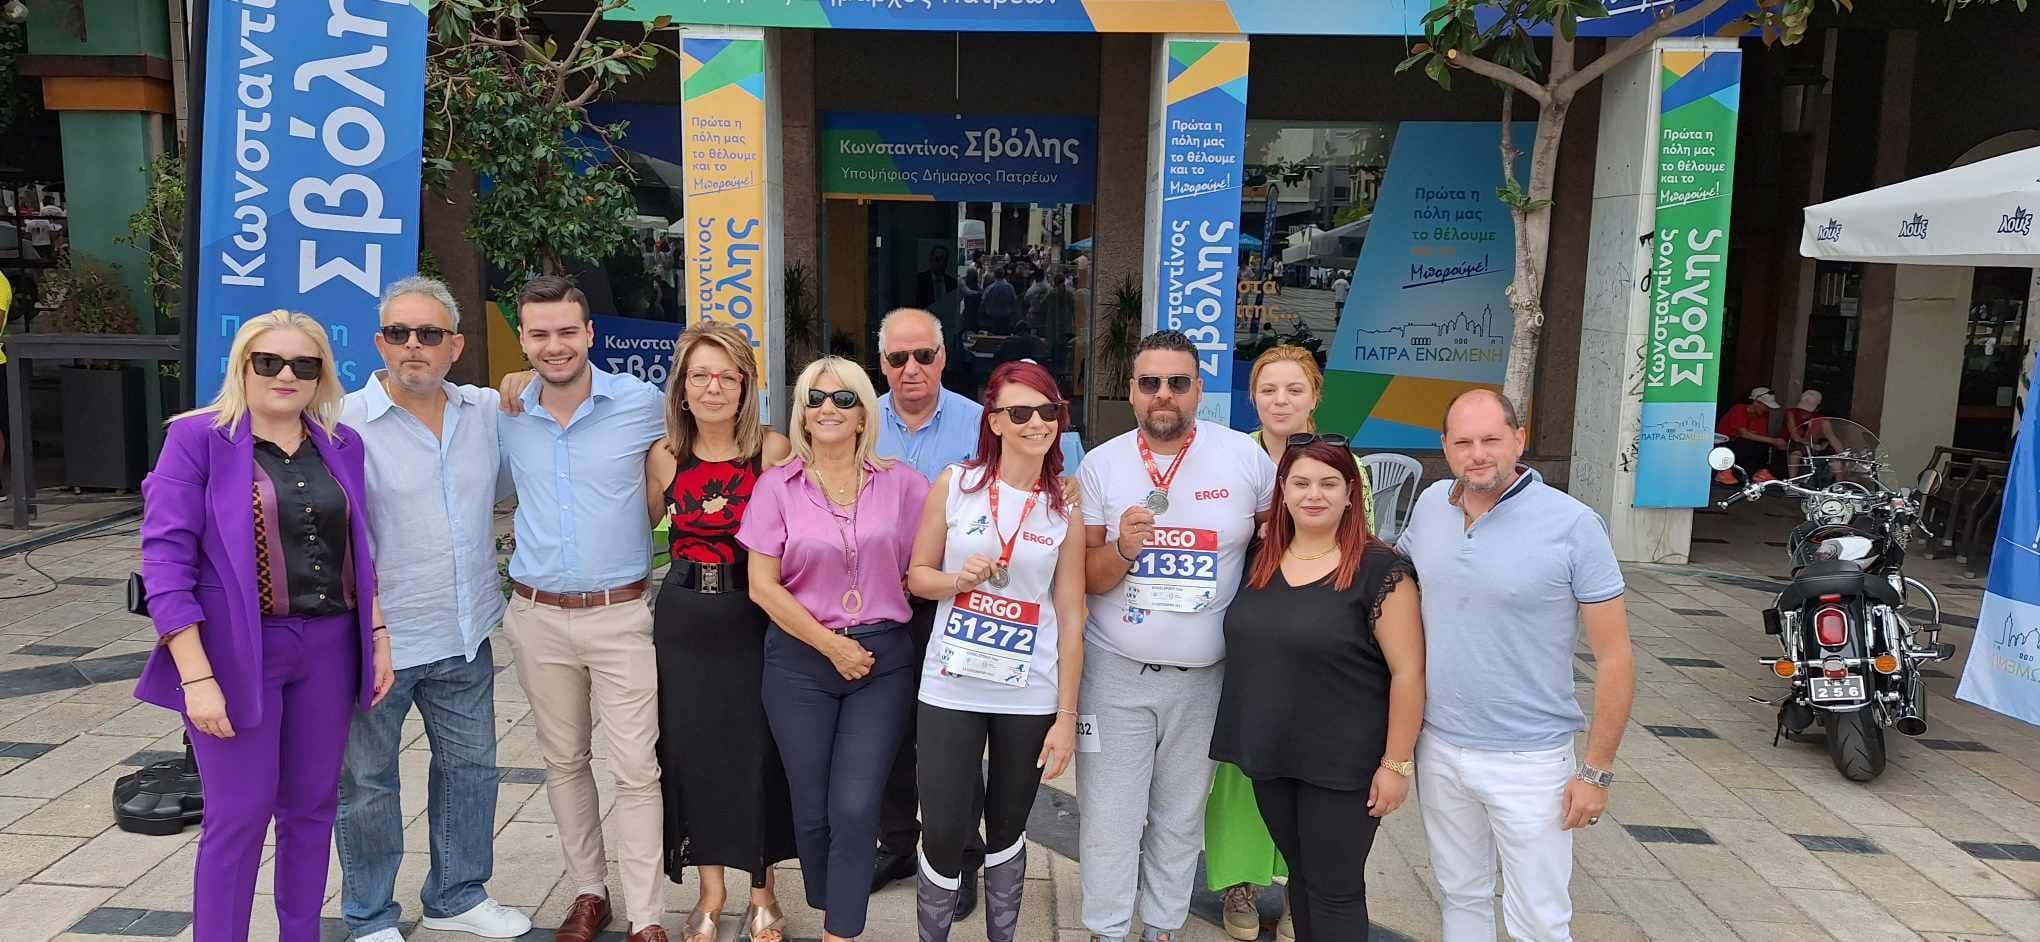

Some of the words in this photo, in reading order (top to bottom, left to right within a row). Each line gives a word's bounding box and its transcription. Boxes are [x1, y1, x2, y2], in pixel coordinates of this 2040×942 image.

[691, 116, 731, 128] Πρώτα
[735, 119, 742, 130] η
[1171, 119, 1212, 132] Πρώτα
[1215, 123, 1222, 133] η
[692, 131, 720, 144] πόλη
[724, 135, 746, 144] μας
[1171, 134, 1200, 148] πόλη
[1203, 137, 1225, 148] μας
[1663, 128, 1703, 141] Πρώτα
[1706, 131, 1713, 141] η
[221, 0, 277, 287] Κωνσταντί
[289, 0, 409, 297] Σβόλη
[839, 138, 960, 159] Κωνσταντίνος
[964, 127, 1080, 165] Σβόλης
[1663, 143, 1691, 156] πόλη
[1694, 147, 1716, 156] μας
[693, 151, 705, 159] το
[709, 148, 757, 161] θέλουμε
[1171, 155, 1184, 163] το
[1187, 152, 1236, 165] θέλουμε
[692, 162, 711, 171] και
[714, 163, 727, 171] το
[1170, 167, 1188, 175] και
[1191, 167, 1205, 175] το
[1662, 163, 1674, 171] το
[1678, 160, 1726, 173] θέλουμε
[841, 166, 918, 185] Υποψήφιος
[922, 167, 991, 185] Δήμαρχος
[996, 169, 1058, 185] Πατρέων
[1661, 175, 1678, 183] και
[1681, 175, 1695, 183] το
[1415, 186, 1466, 202] Πρώτα
[1471, 191, 1480, 203] η
[1414, 206, 1450, 222] πόλη
[1456, 209, 1483, 222] μας
[1412, 231, 1429, 240] το
[1434, 227, 1496, 243] θέλουμε
[693, 217, 716, 322] ταντίνος
[1164, 219, 1190, 331] σταντίνος
[1647, 228, 1680, 387] Κωνσταντίνος
[1668, 228, 1723, 387] Σβόλης
[605, 335, 677, 350] Κωνσταν
[1355, 346, 1410, 361] ΠΑΤΡΑ
[1415, 347, 1503, 363] ΕΝΩΜΕΝΗ
[606, 354, 673, 384] Σβό
[1195, 488, 1229, 501] ERGO
[1022, 531, 1054, 546] ERGO
[968, 592, 1021, 619] ERGO
[947, 611, 1034, 652] 51272
[1818, 687, 1859, 698] 256
